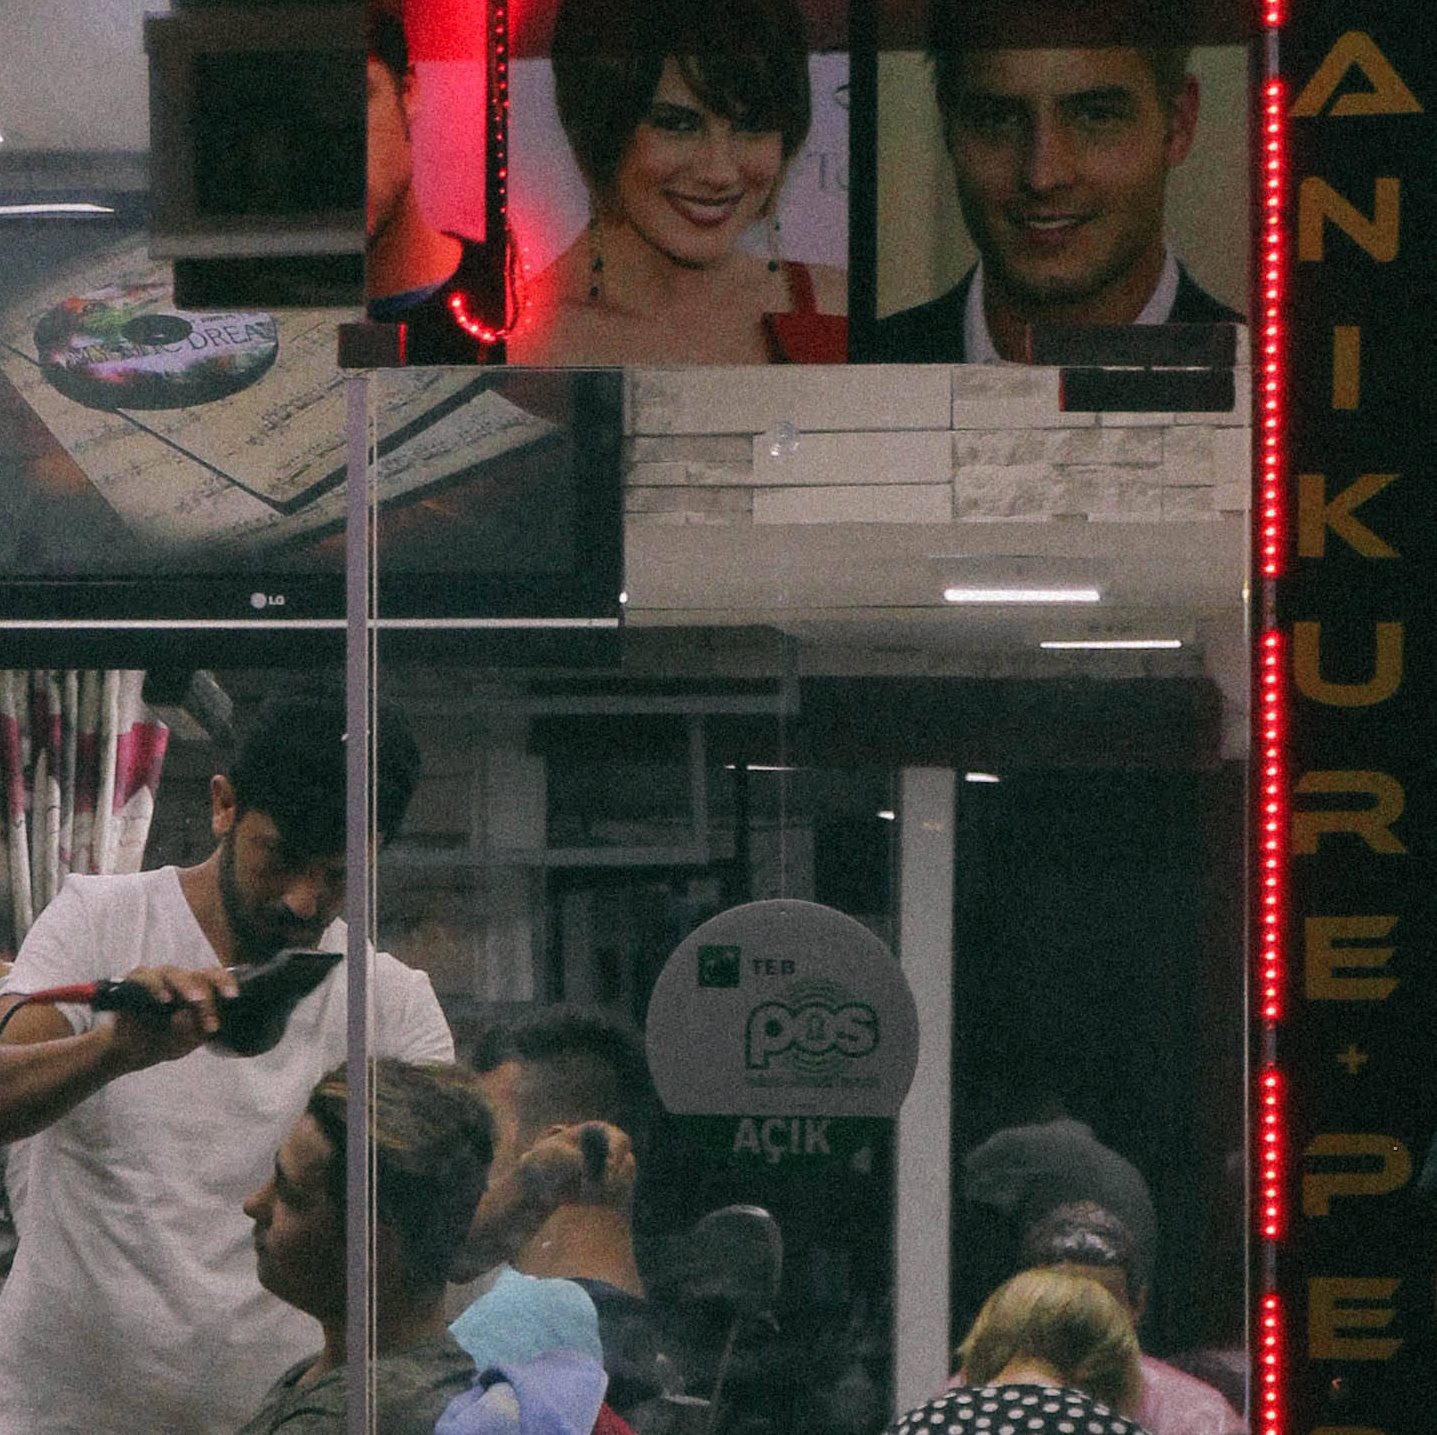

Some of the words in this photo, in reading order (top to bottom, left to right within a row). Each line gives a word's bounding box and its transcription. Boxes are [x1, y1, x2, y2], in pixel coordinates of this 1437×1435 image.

[267, 594, 286, 606] LG
[750, 959, 796, 976] TEB
[732, 1118, 832, 1164] AÇIK
